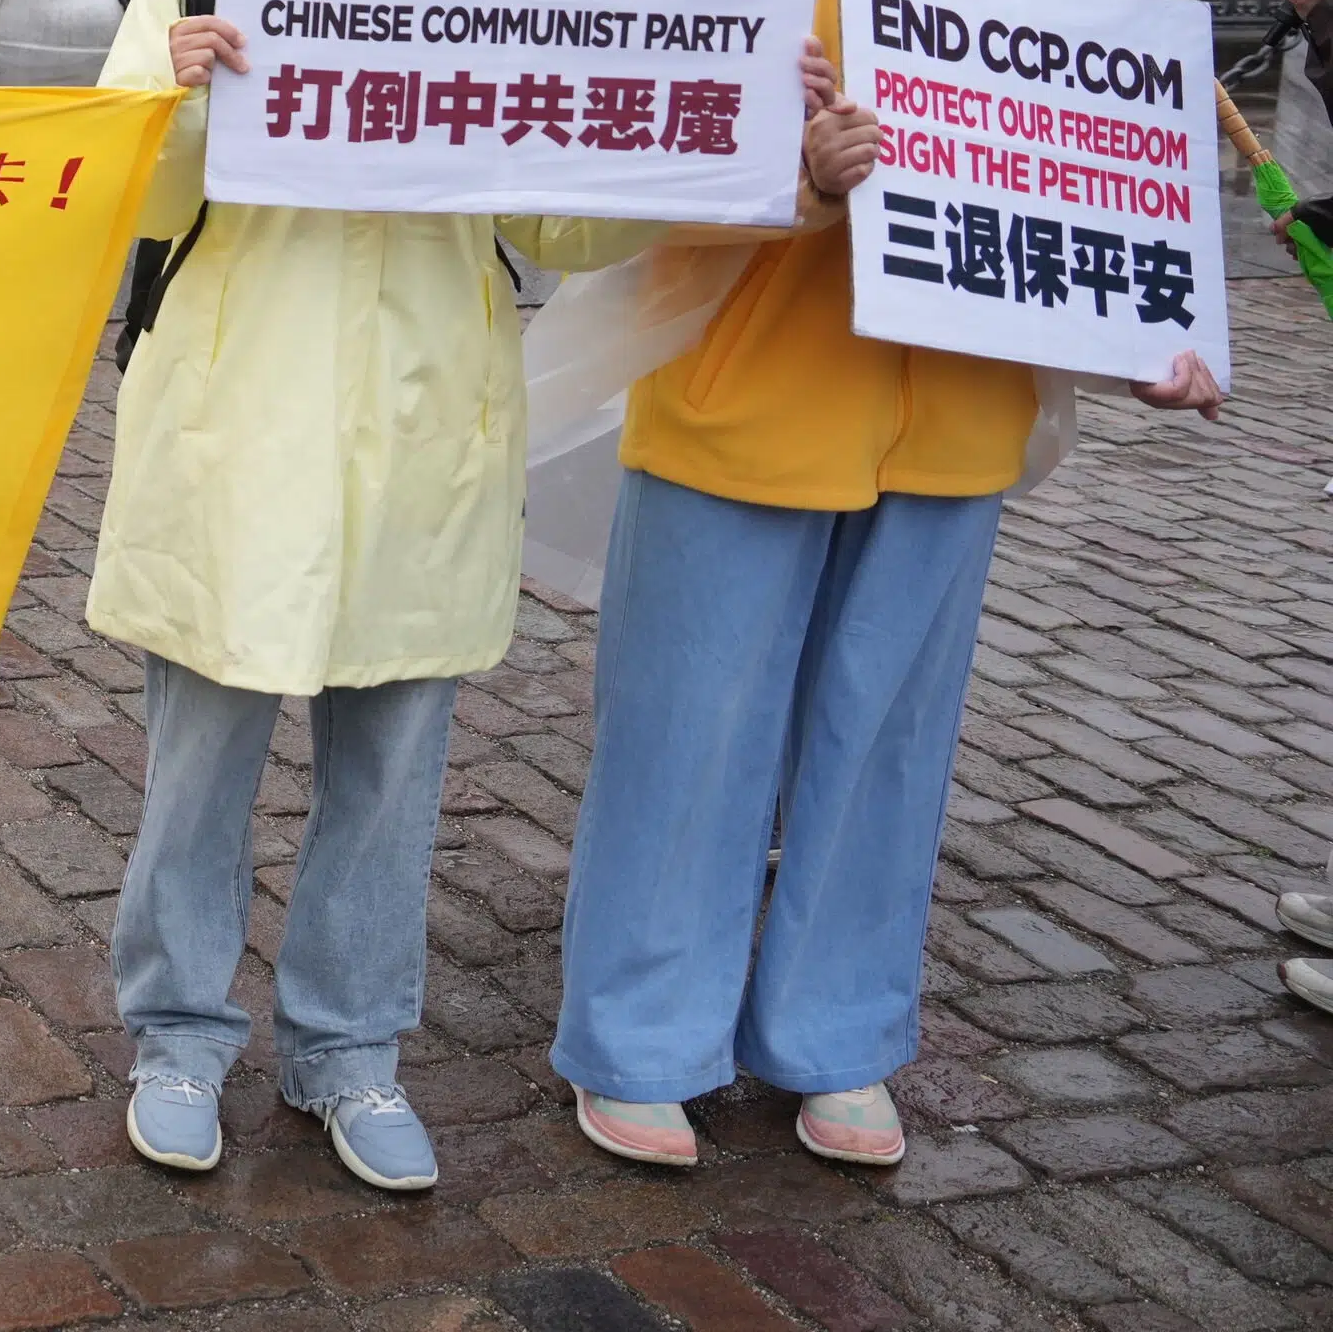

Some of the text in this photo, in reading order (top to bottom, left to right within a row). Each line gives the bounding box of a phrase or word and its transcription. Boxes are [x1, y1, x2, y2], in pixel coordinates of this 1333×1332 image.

[421, 5, 638, 49] COMMUNIST
[643, 13, 766, 54] PARTY
[978, 19, 1184, 111] CCP.COM
[265, 63, 743, 156] 打倒中共恶魔
[874, 68, 1188, 171] PROTECT OUR FREEDOM
[877, 123, 1191, 224] SIGN THE PETITION
[882, 190, 1196, 332] 三退保平安
